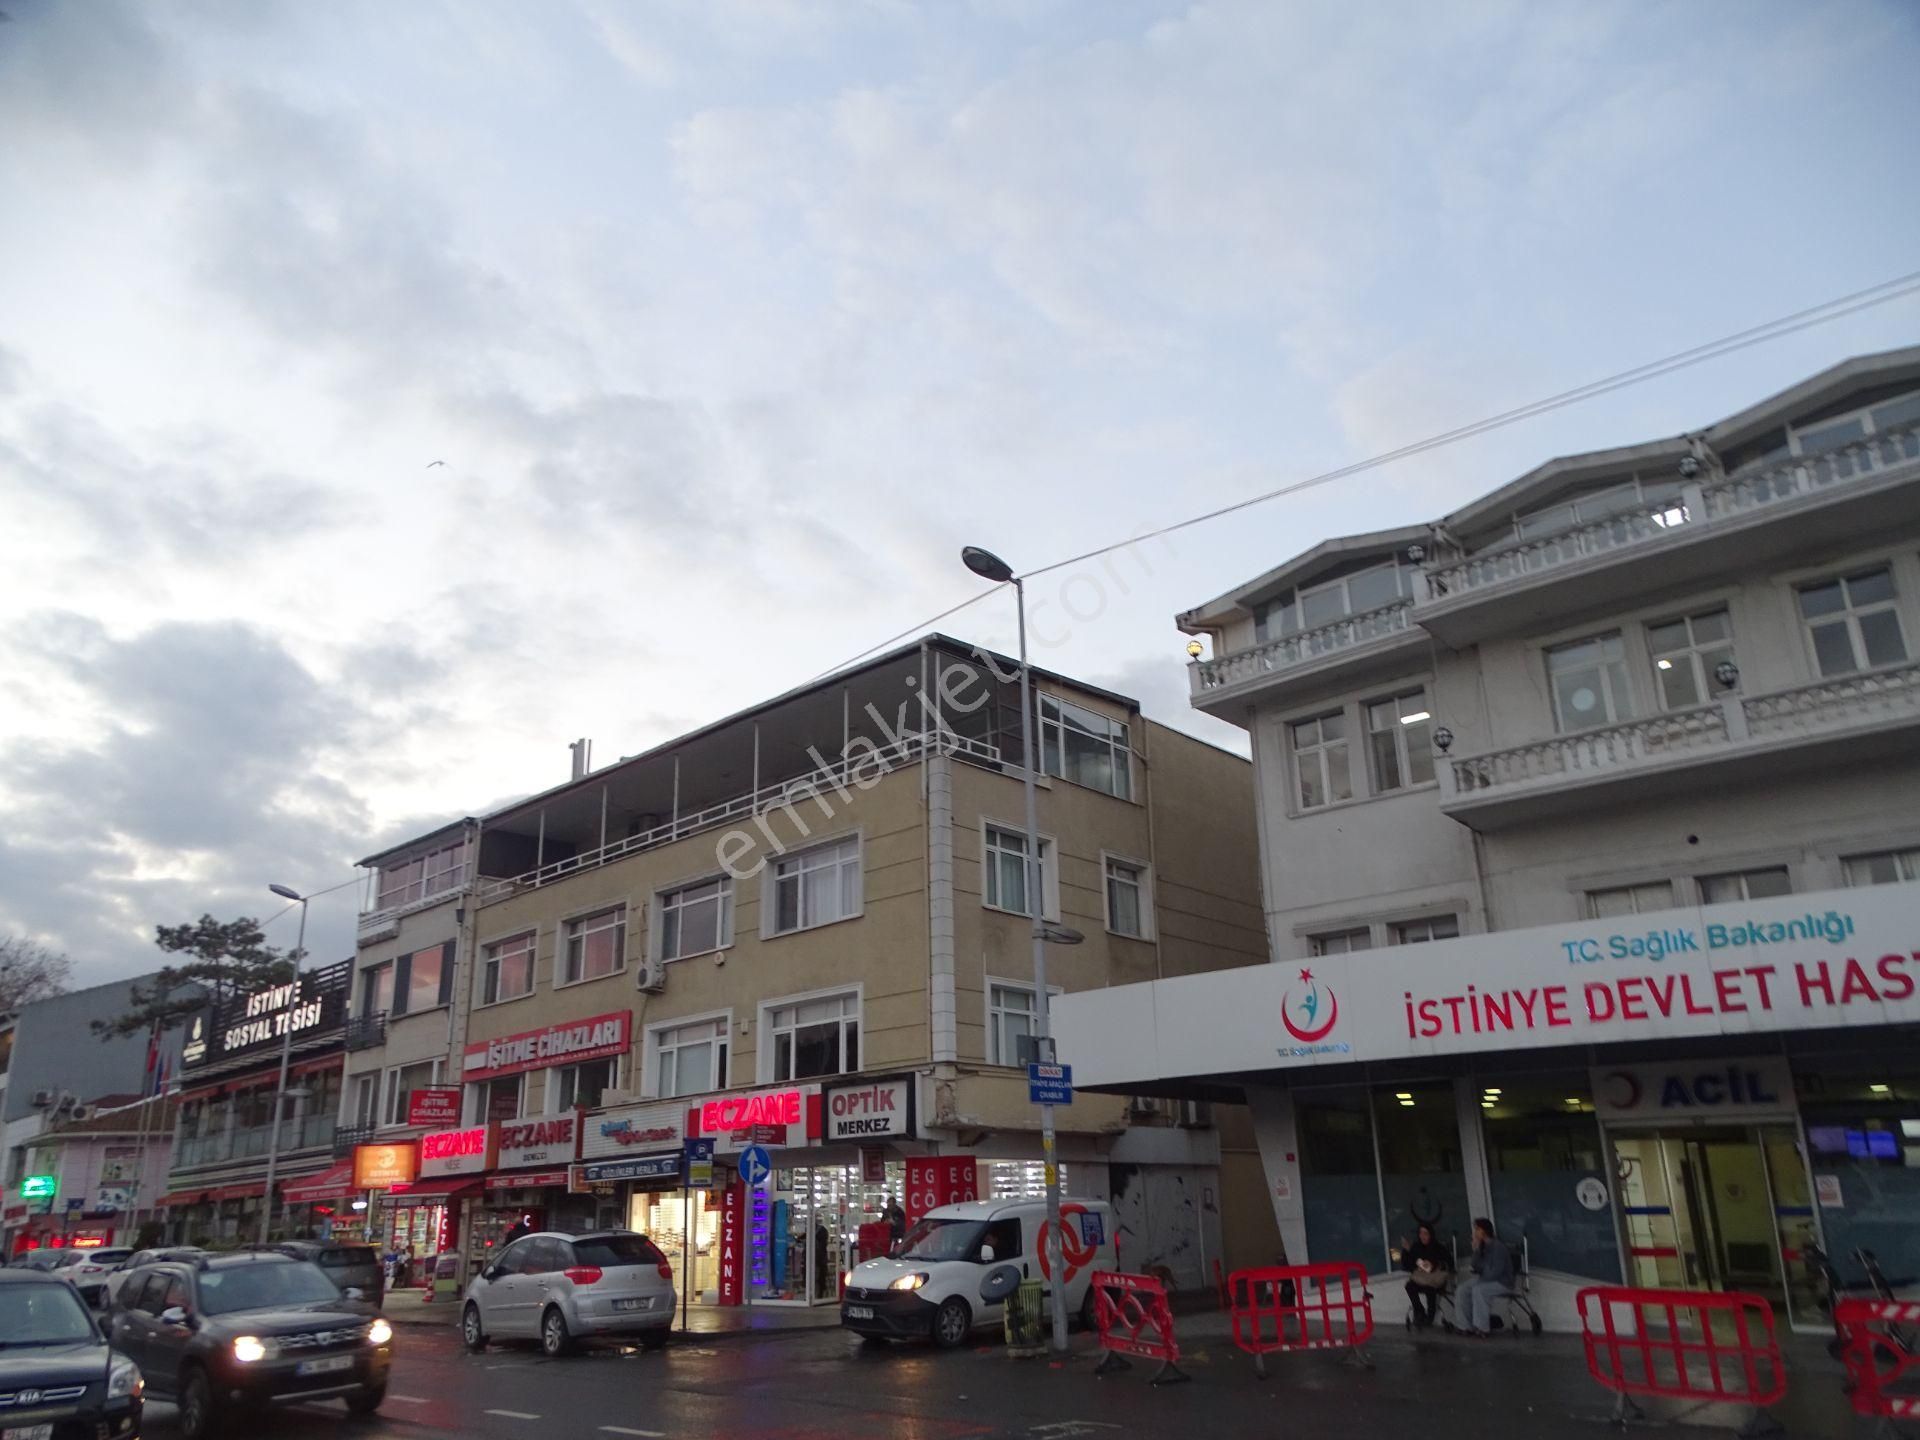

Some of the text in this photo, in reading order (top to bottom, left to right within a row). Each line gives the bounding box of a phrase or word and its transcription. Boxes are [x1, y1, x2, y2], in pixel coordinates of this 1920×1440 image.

[1608, 928, 1699, 962] Sağlık
[1707, 910, 1855, 950] Bakanlığı
[1405, 951, 1920, 1040] İSTİNYE DEVLET HAS
[224, 1018, 272, 1051] SOSYAL
[537, 1019, 622, 1057] CİHAZLARI
[832, 1085, 895, 1116] OPTİK
[1660, 1065, 1780, 1107] ACİL
[703, 1092, 800, 1132] ECZANE
[837, 1118, 890, 1135] MERKEZ
[501, 1118, 573, 1150] ECZANE
[724, 1193, 733, 1296] ECZANE
